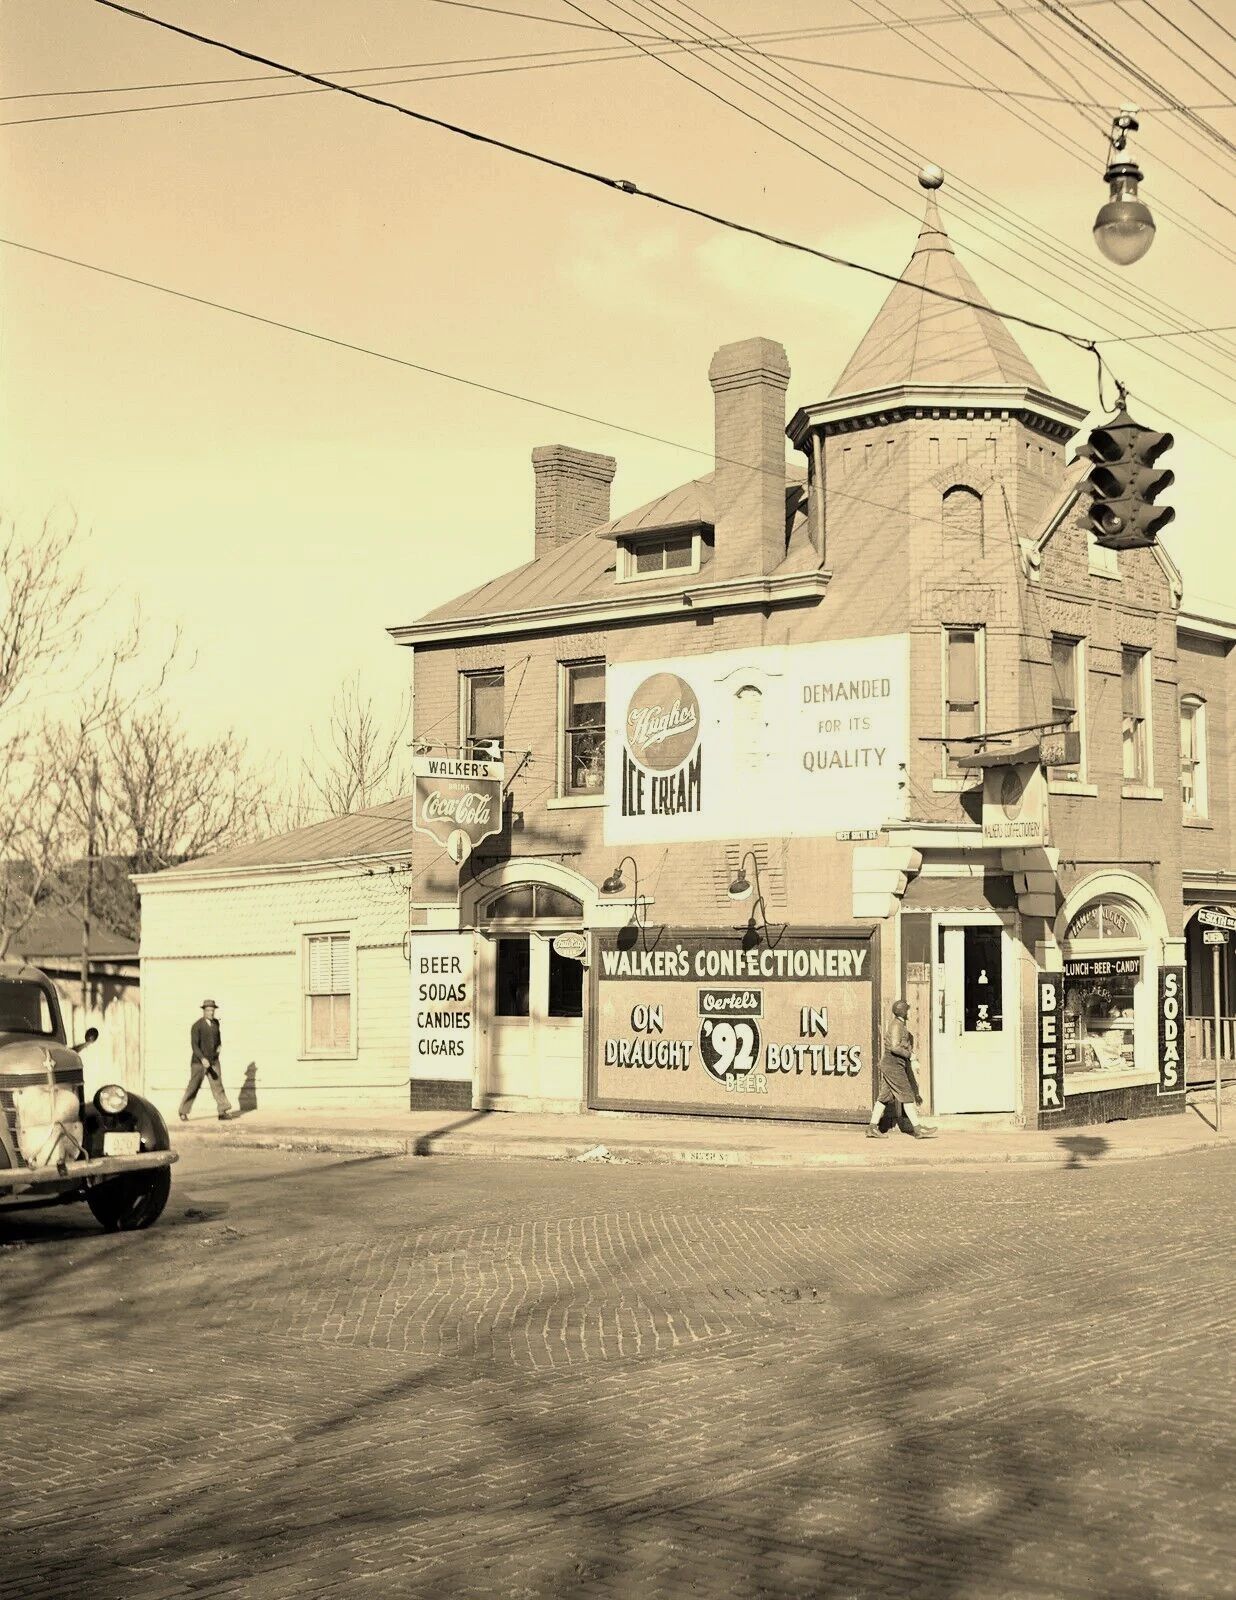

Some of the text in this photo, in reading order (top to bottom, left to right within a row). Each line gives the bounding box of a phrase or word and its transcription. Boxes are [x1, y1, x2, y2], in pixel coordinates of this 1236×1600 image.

[803, 678, 890, 704] DEMANDED
[627, 699, 697, 751] Hughes
[818, 717, 871, 733] FOR ITS
[428, 760, 489, 777] WALKER'S
[803, 747, 886, 772] QUALITY
[622, 742, 701, 816] ICE CREAM
[421, 790, 492, 824] Coca-Cola
[420, 956, 462, 974] BEER
[602, 945, 867, 977] WALKER'S CONFECTIONERY
[419, 983, 467, 1001] SODAS
[417, 1012, 470, 1028] CANDIES
[631, 1004, 664, 1034] ON
[800, 1006, 829, 1037] IN
[1163, 973, 1180, 1087] SODAS
[418, 1039, 464, 1056] CIGARS
[604, 1038, 694, 1071] DRAUGHT
[704, 1020, 754, 1075] '92
[765, 1043, 862, 1076] BOTTLES
[1041, 983, 1060, 1106] BEER
[725, 1073, 768, 1093] BEER
